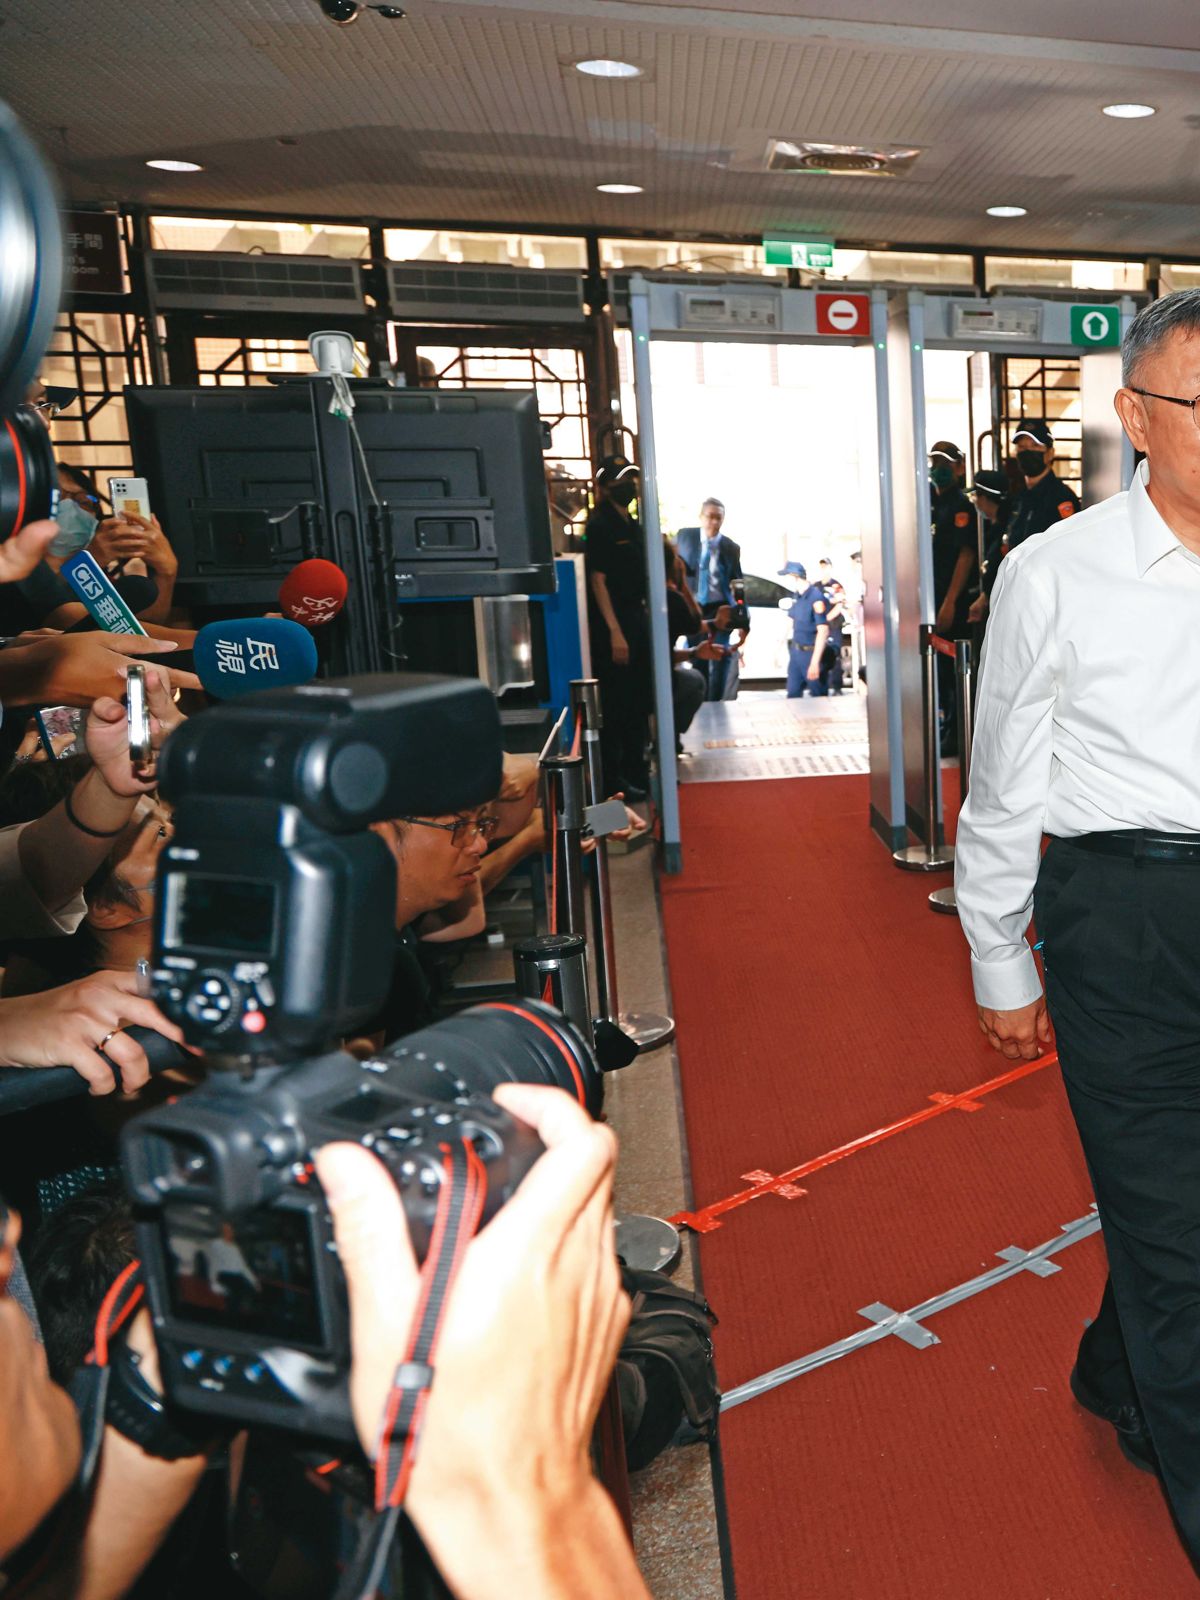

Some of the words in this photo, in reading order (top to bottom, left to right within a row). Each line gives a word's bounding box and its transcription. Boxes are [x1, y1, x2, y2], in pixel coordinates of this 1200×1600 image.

[65, 232, 103, 250] 手間
[74, 566, 102, 597] CTS
[215, 637, 279, 675] 民視
